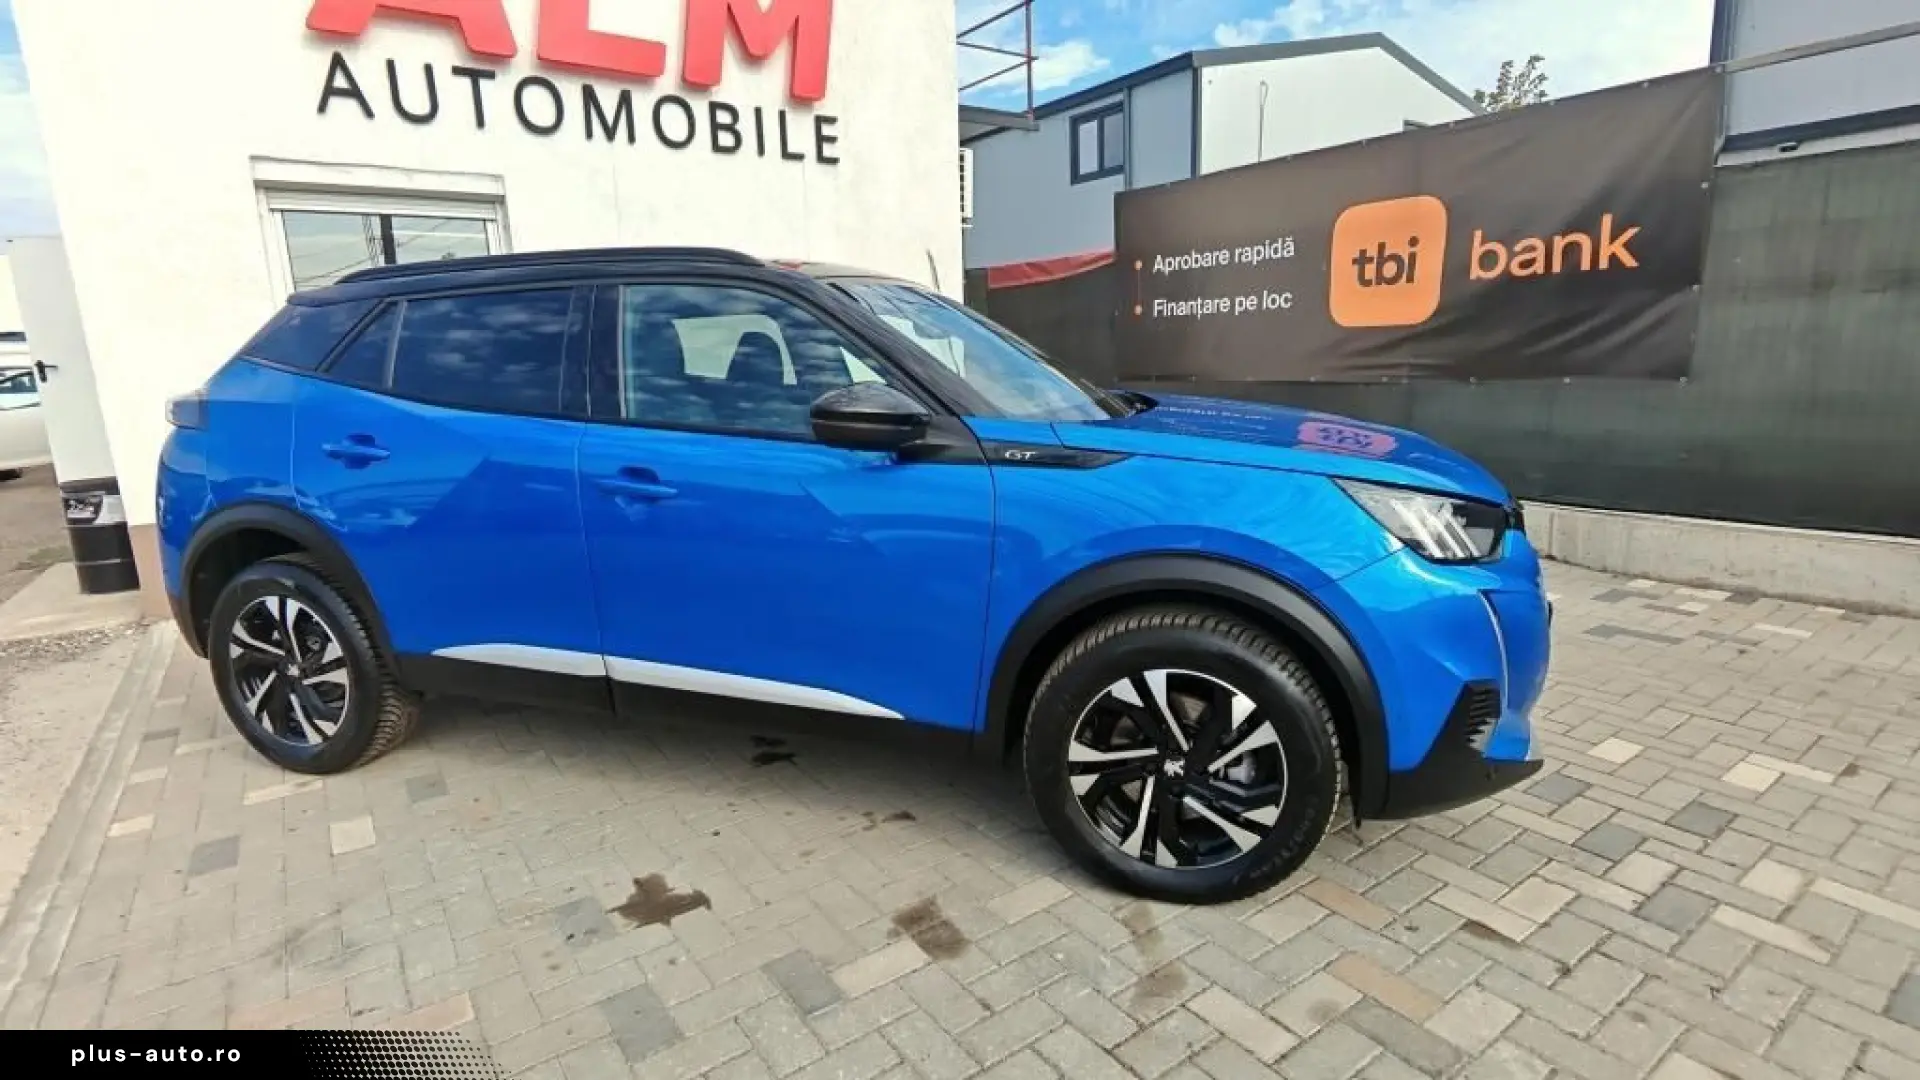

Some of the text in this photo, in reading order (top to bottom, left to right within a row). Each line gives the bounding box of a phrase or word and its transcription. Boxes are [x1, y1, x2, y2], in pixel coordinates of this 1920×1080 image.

[316, 51, 841, 165] AUTOMOBILE
[1153, 236, 1295, 276] Aprobare rapidă
[1352, 235, 1419, 288] tbi
[1469, 213, 1641, 281] bank
[1153, 290, 1293, 320] Finanțare pe loc
[1004, 449, 1036, 460] GT
